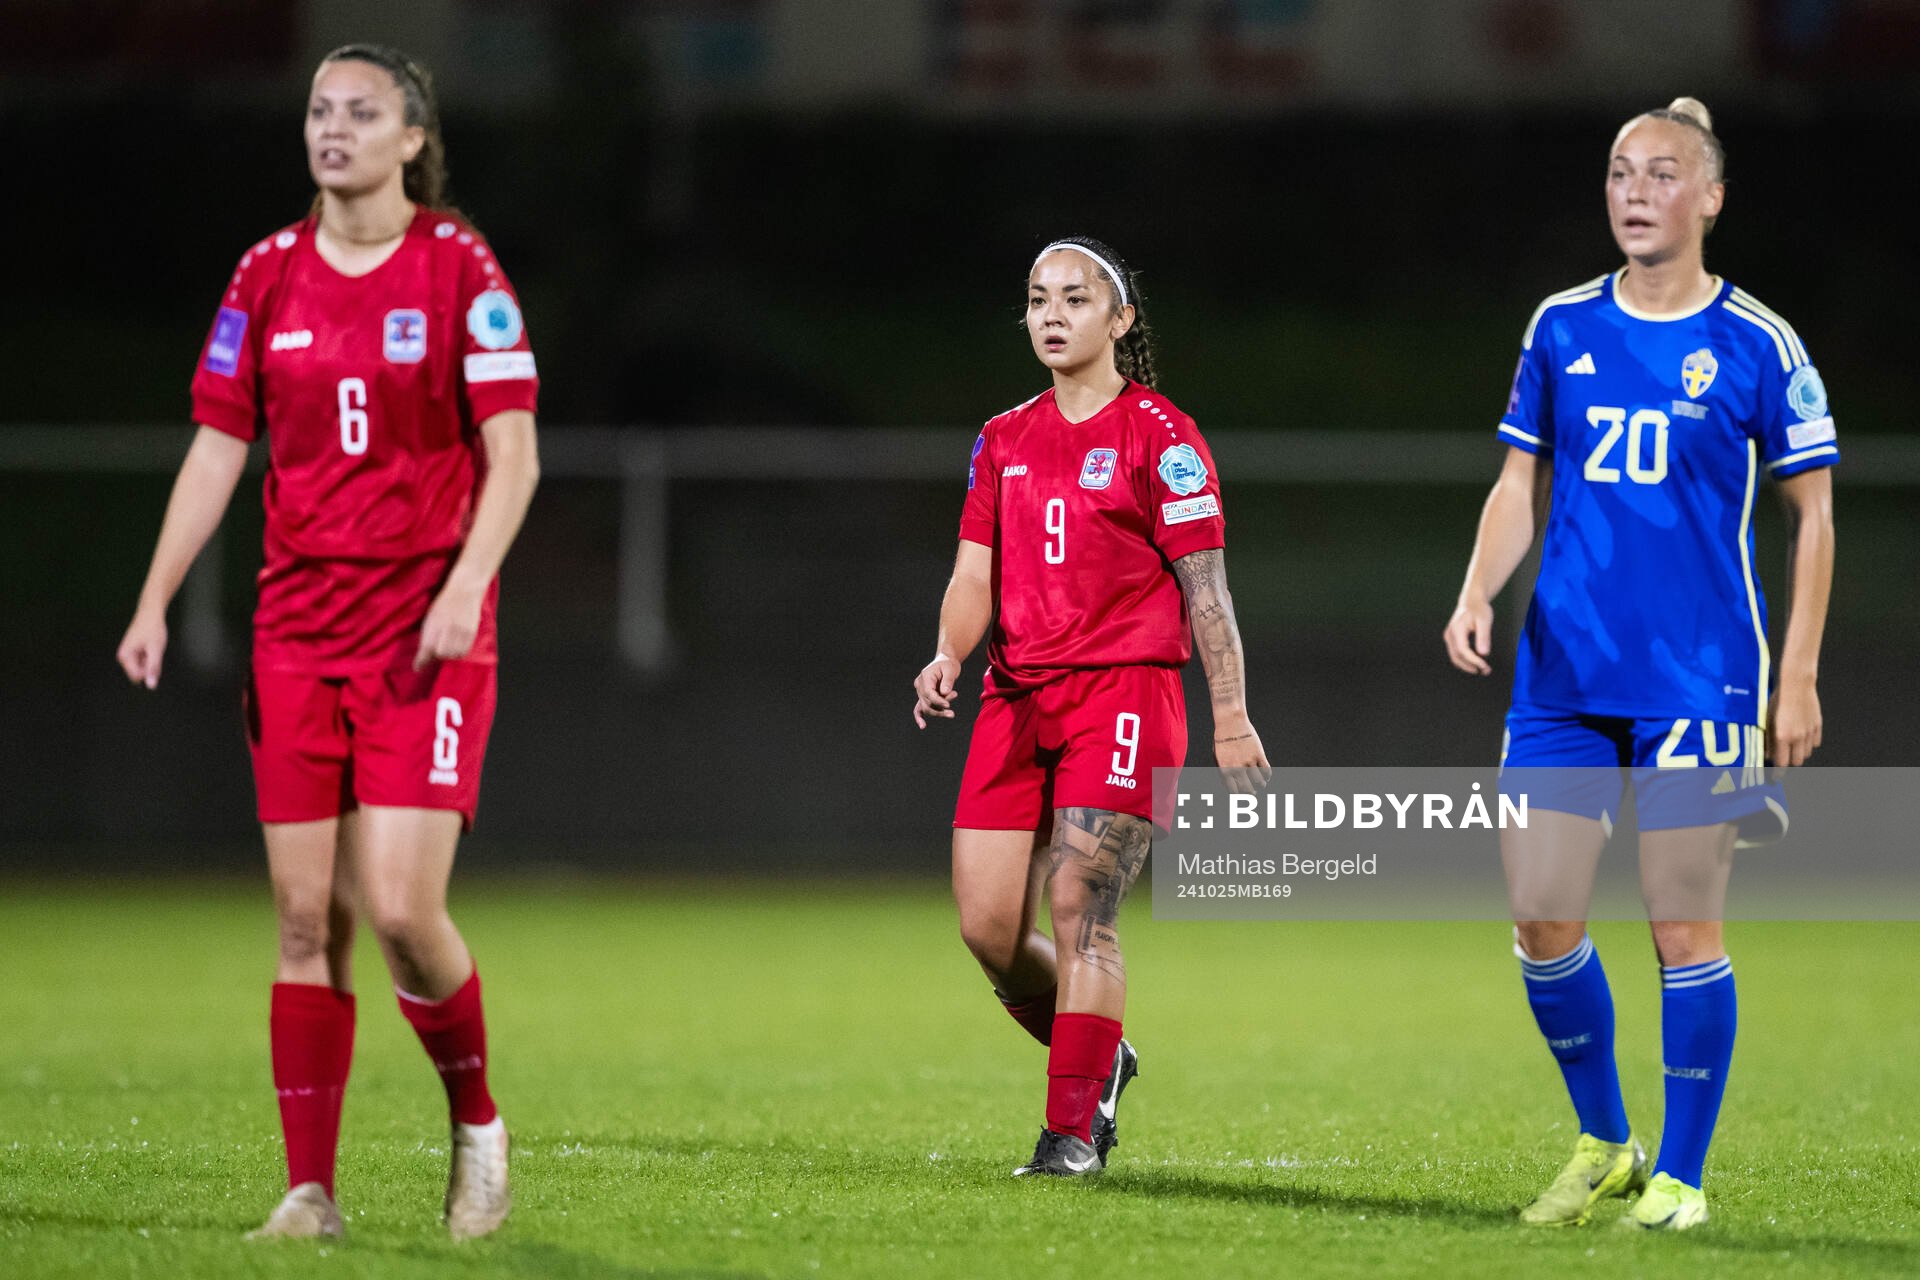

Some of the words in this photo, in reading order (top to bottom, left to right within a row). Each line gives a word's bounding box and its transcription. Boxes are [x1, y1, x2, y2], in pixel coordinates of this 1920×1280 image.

[338, 378, 368, 456] 6
[1584, 406, 1670, 485] 20
[1002, 465, 1028, 477] JAKO
[1045, 498, 1065, 564] 9
[433, 696, 463, 769] 6
[1111, 712, 1140, 776] 9
[1105, 774, 1137, 789] JAKO
